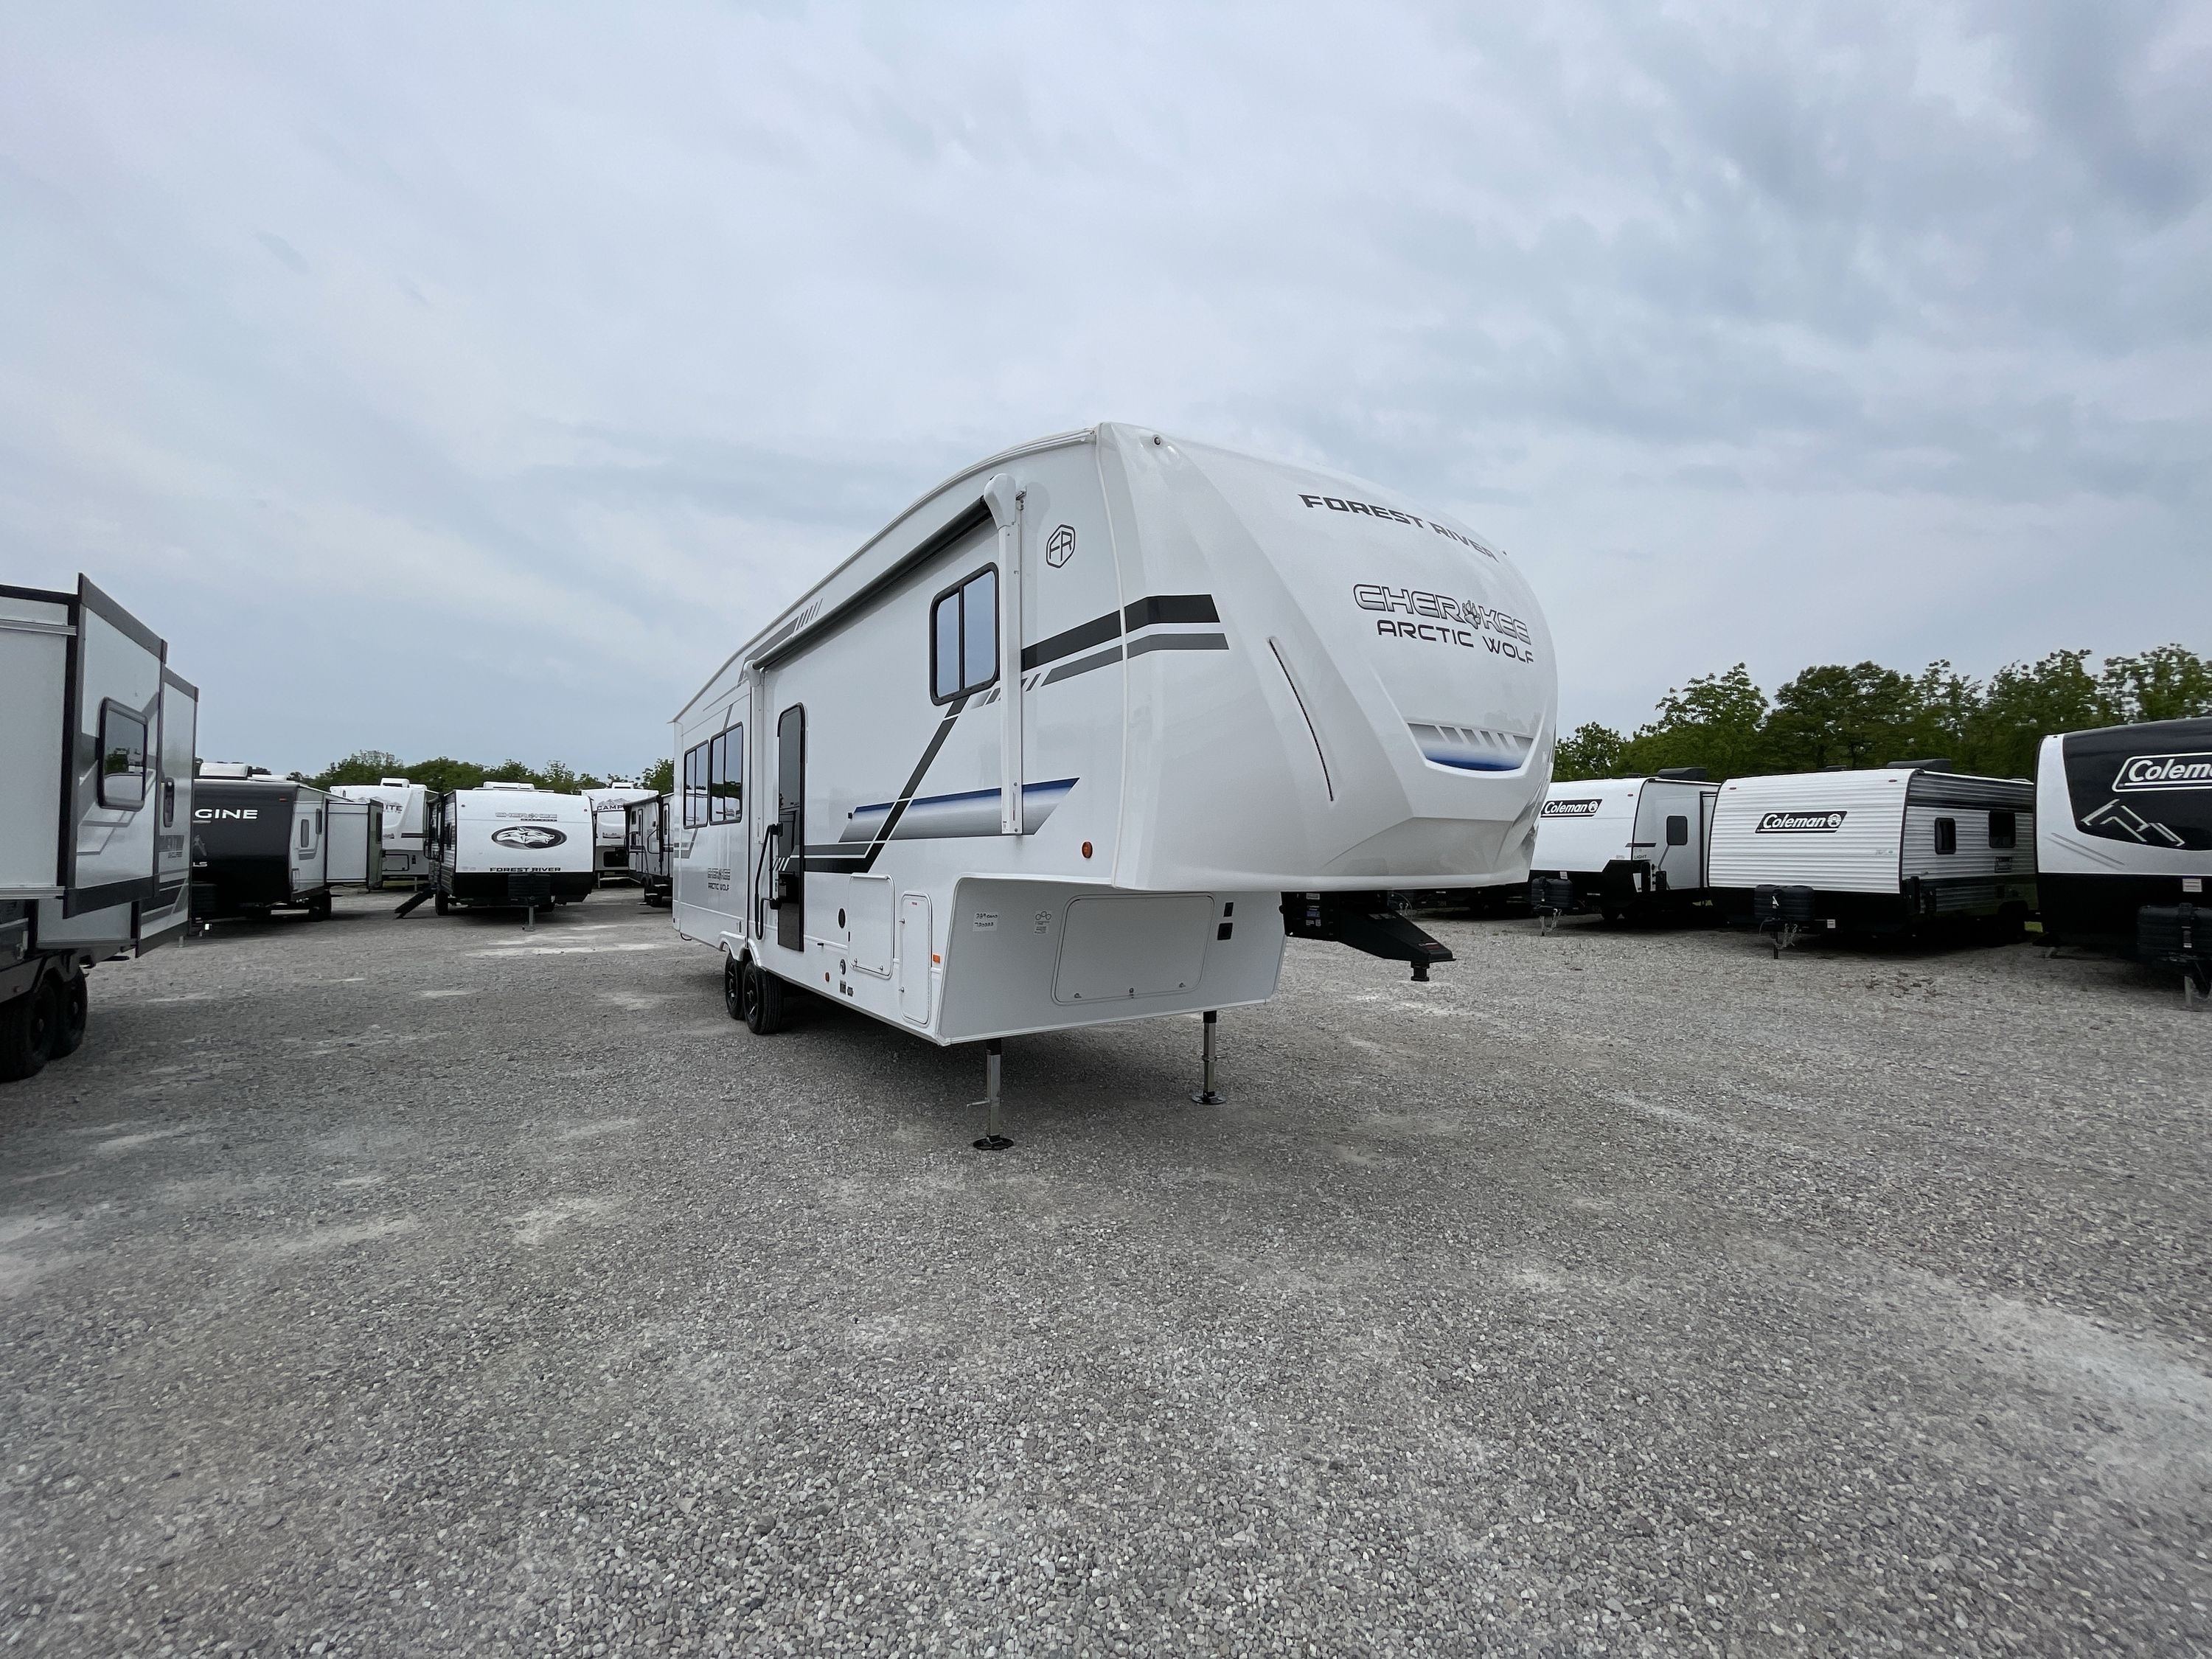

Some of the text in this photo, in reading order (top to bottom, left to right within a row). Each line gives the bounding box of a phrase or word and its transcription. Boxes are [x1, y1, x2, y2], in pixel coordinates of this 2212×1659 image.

[1298, 494, 1500, 563] FOREST RIVER
[1377, 619, 1534, 664] ARCTIC WOLF
[2128, 758, 2212, 782] Colem
[194, 808, 258, 819] GINE
[1544, 801, 1588, 814] Coleman
[1763, 813, 1826, 829] Coleman
